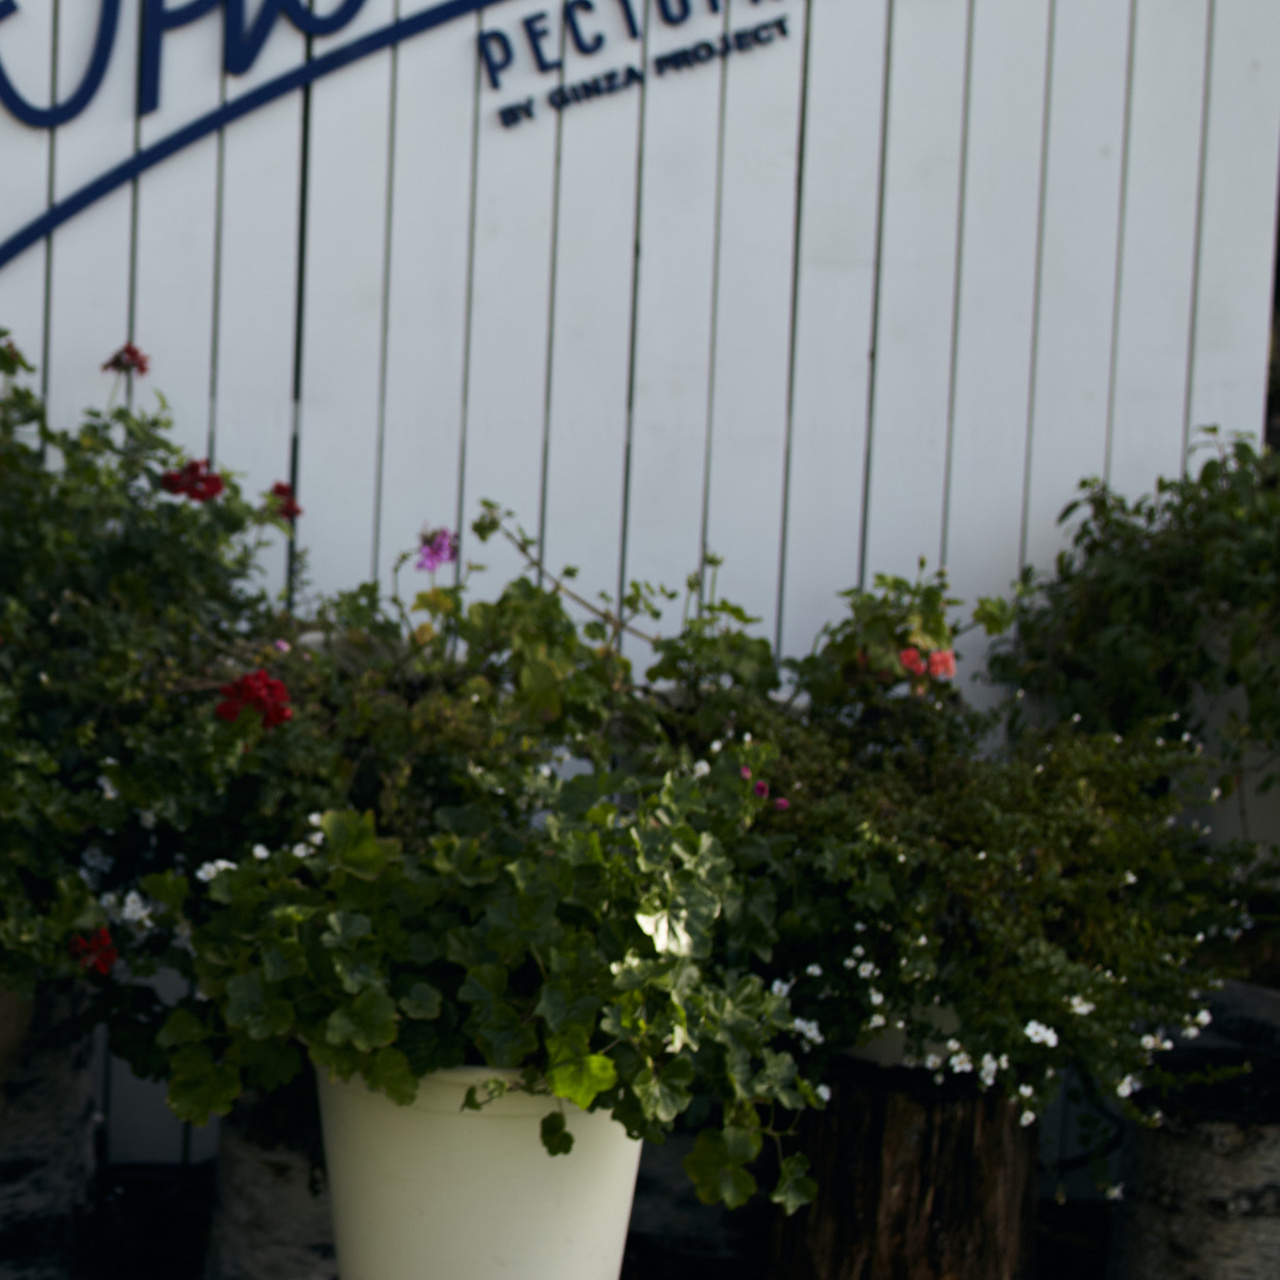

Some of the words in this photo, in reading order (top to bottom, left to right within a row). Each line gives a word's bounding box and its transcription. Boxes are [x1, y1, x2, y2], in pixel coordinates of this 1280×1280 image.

[497, 97, 535, 131] BY
[546, 65, 644, 111] GINZA
[653, 14, 790, 77] PROJECT
